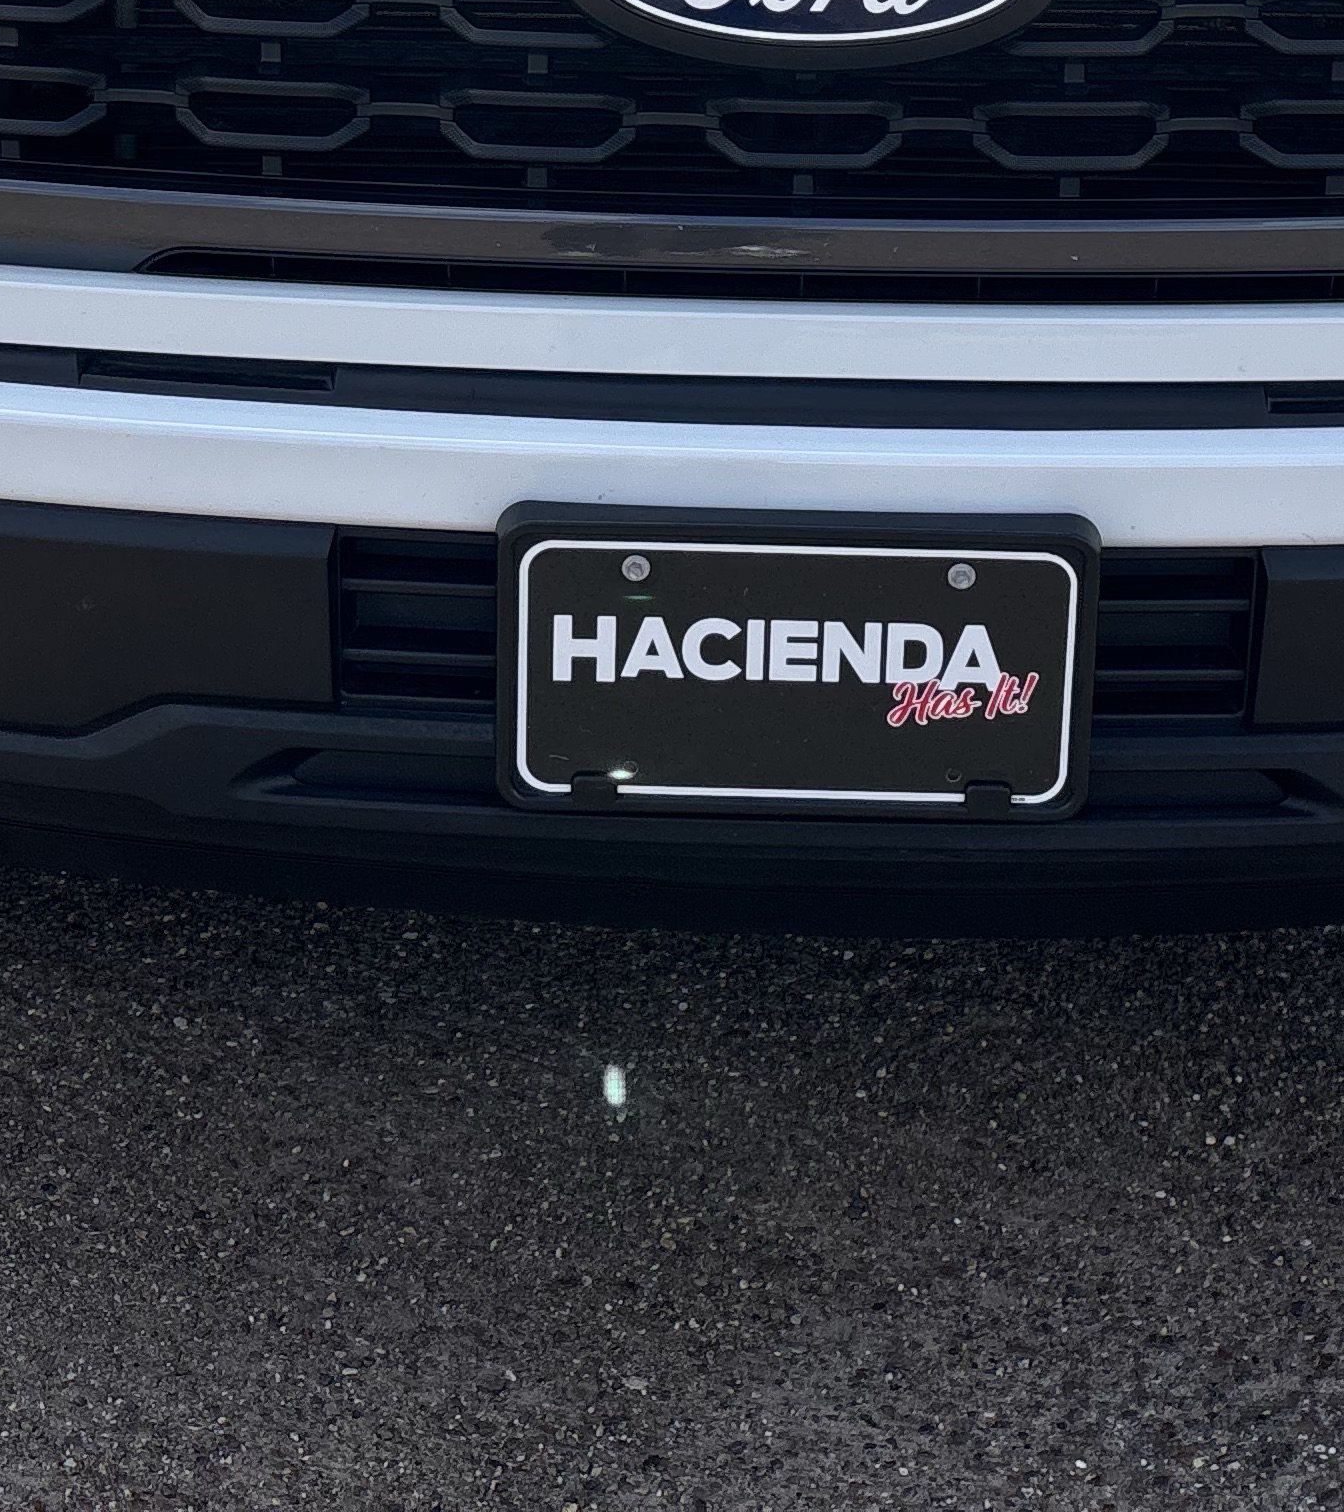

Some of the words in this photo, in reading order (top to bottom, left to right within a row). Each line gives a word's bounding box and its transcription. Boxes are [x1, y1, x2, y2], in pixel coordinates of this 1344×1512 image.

[552, 613, 1002, 692] HACIENDA
[887, 678, 982, 727] Has
[985, 672, 1039, 720] It!
